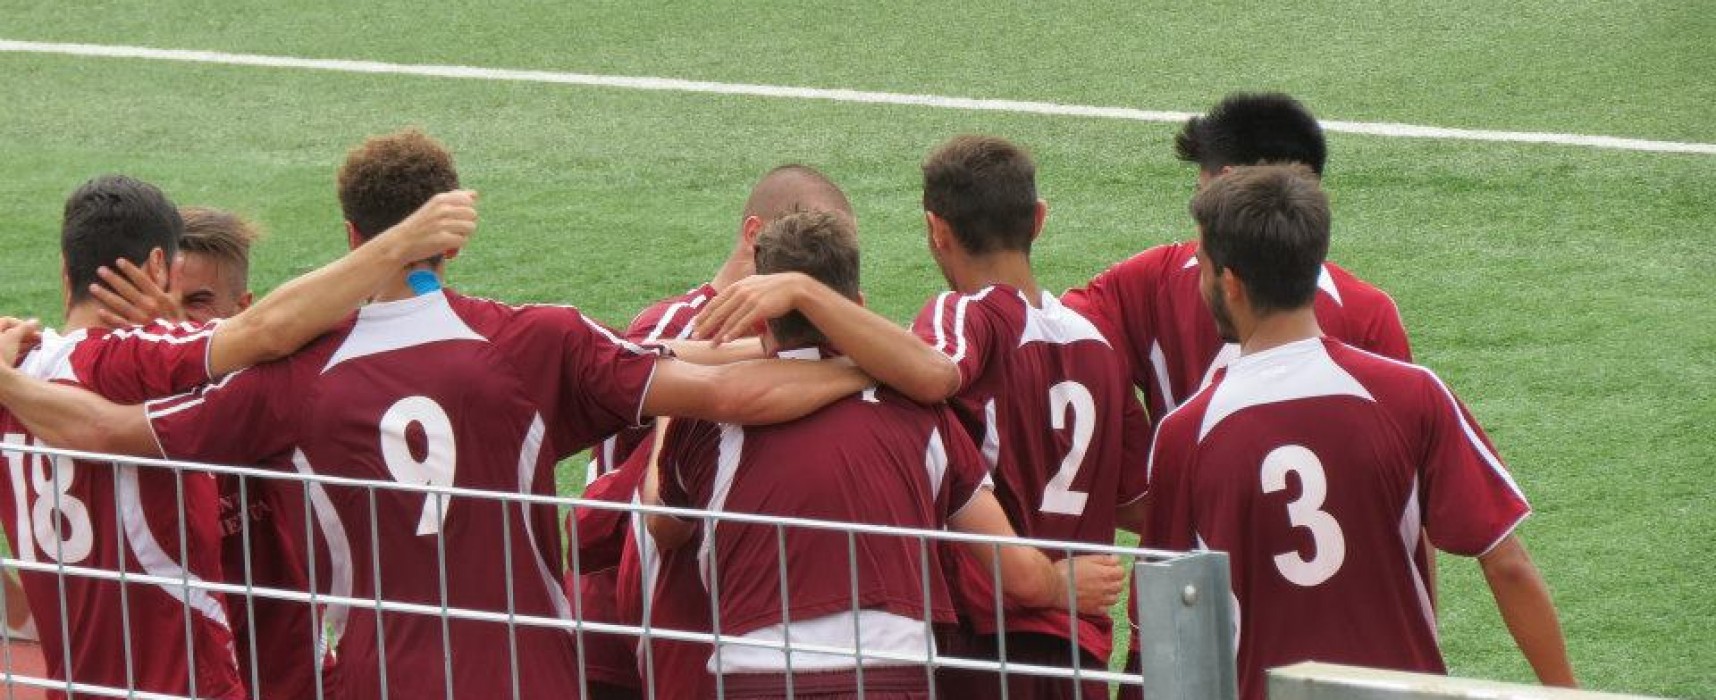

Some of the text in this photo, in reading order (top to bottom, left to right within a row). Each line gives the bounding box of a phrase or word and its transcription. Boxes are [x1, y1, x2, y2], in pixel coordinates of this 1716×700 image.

[2, 434, 93, 563] 18
[380, 395, 456, 536] 9
[1039, 380, 1096, 516] 2
[1261, 444, 1346, 586] 3
